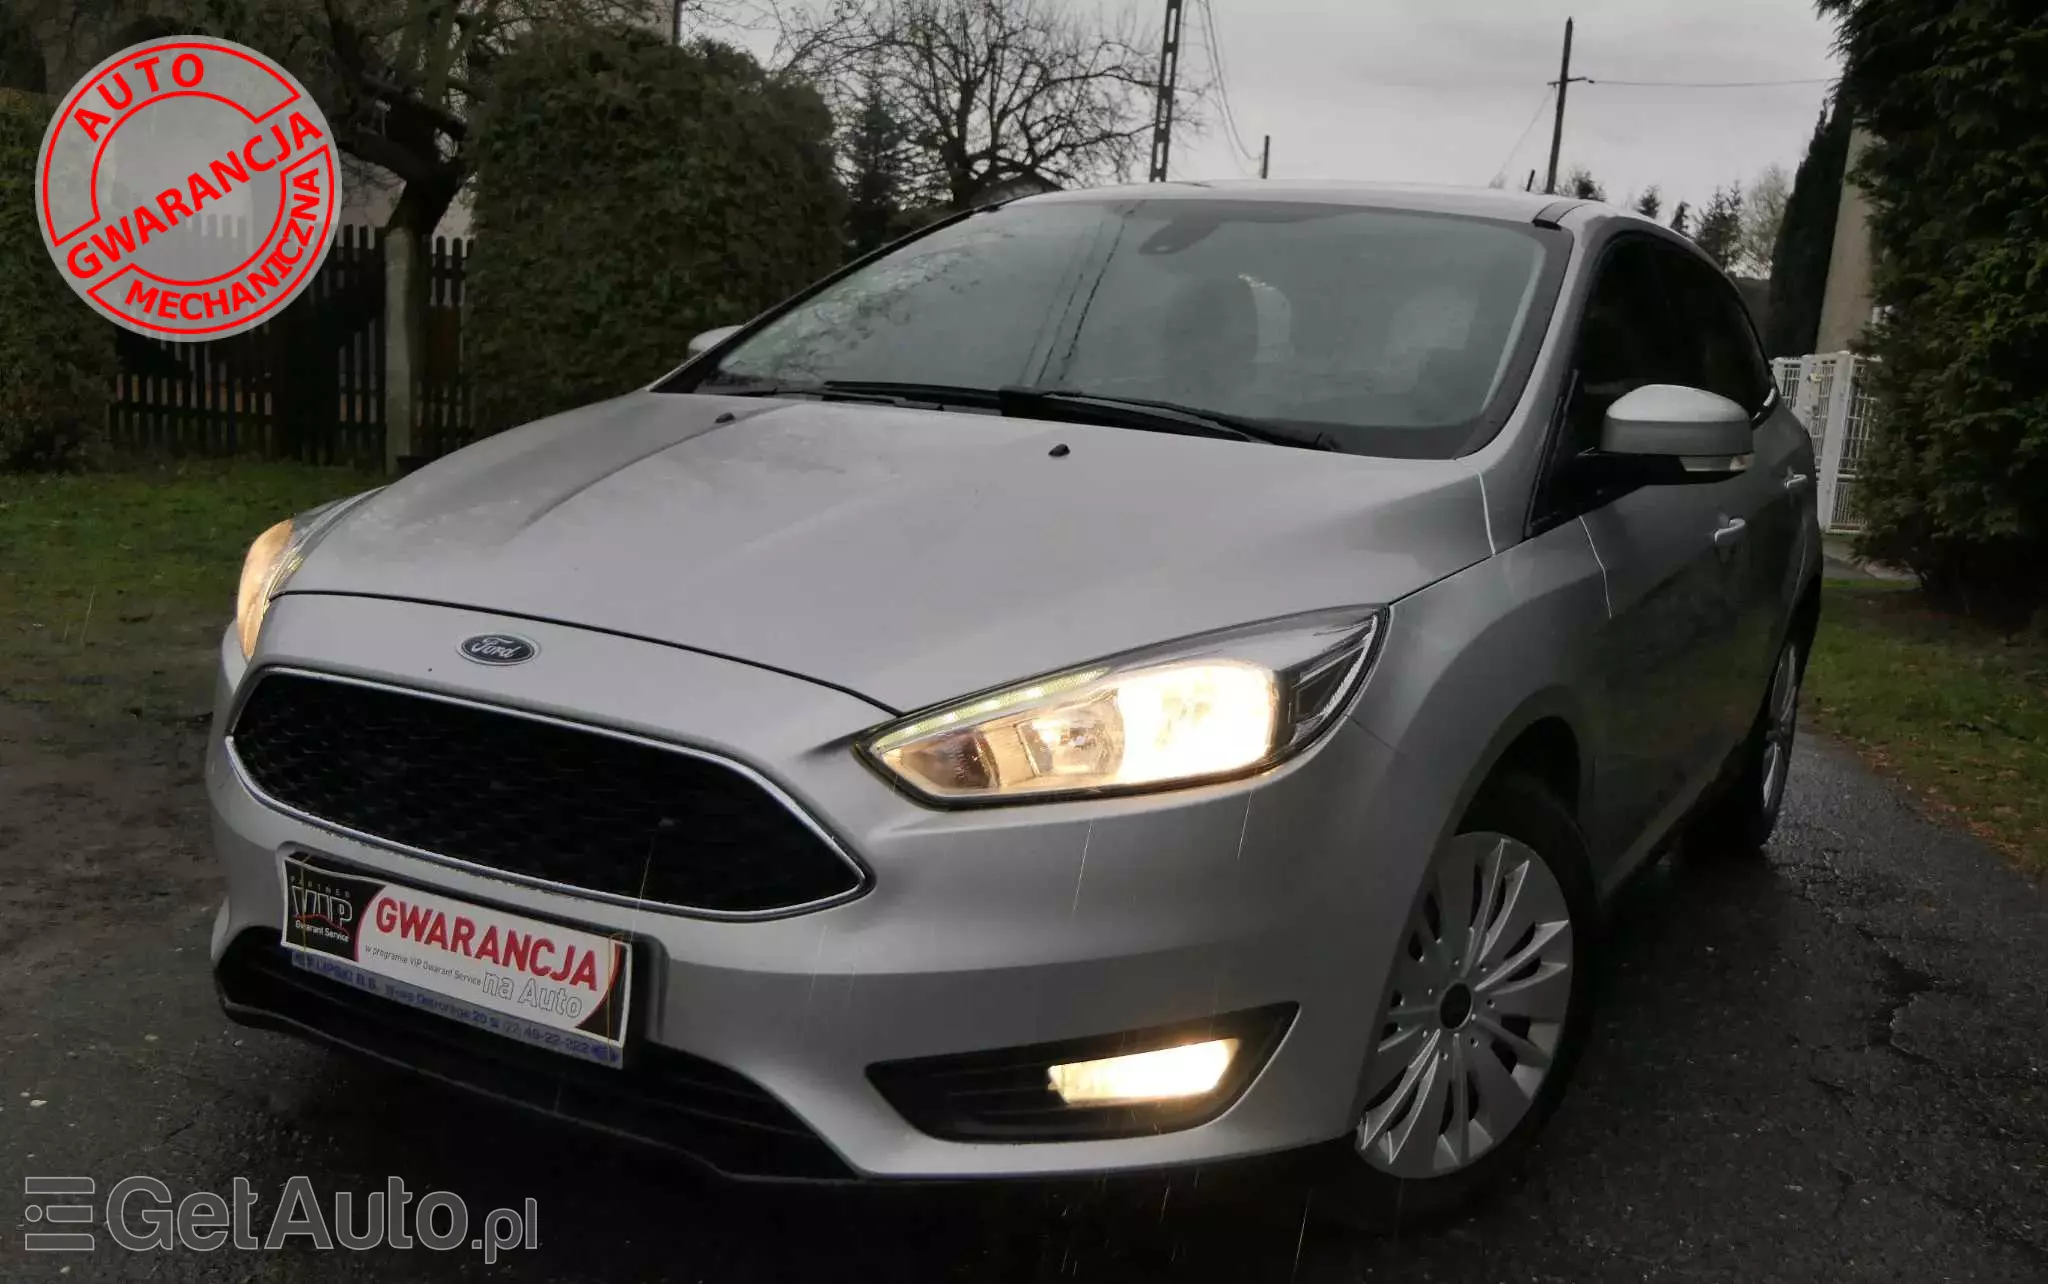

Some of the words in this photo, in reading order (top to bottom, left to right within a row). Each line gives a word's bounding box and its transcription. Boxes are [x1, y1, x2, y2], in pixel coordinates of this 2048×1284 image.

[470, 636, 522, 659] Ford
[324, 927, 350, 943] Service
[375, 896, 598, 992] GWARANCJA
[454, 969, 482, 986] Service
[482, 969, 515, 1001] na
[517, 976, 583, 1019] Auto
